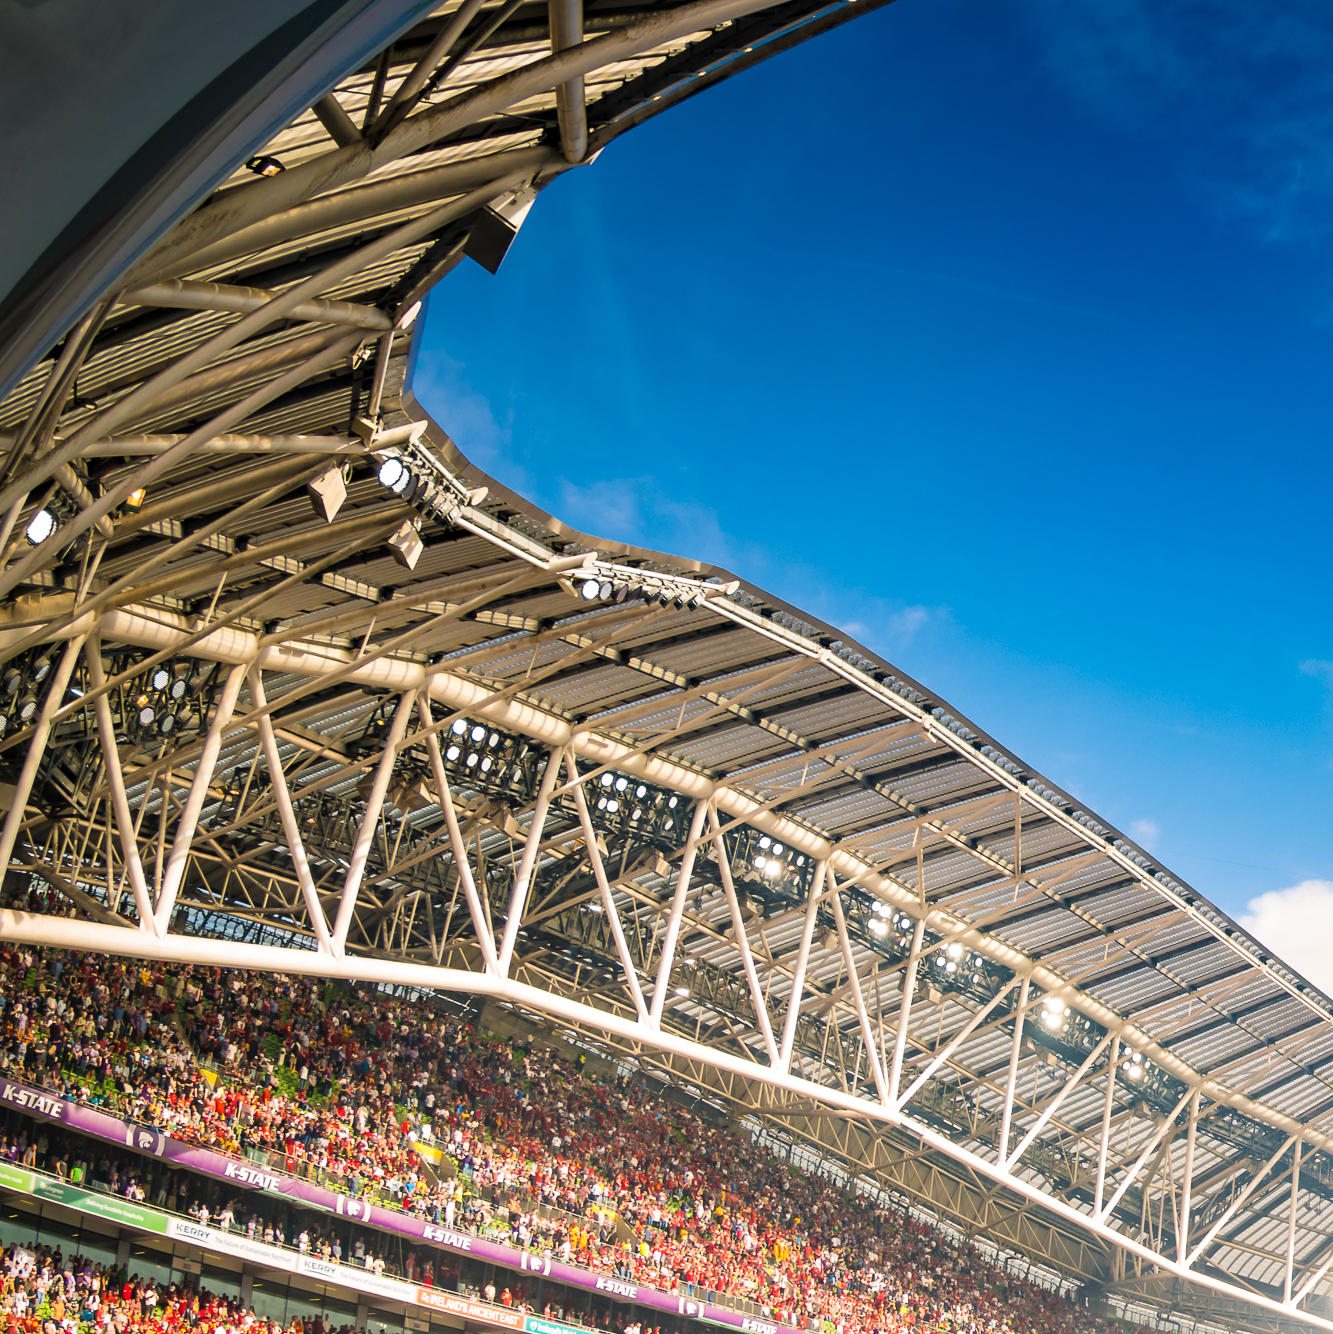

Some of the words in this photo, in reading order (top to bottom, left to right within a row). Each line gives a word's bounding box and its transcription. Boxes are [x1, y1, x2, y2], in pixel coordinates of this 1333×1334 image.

[1, 1084, 63, 1118] K-STATE
[225, 1162, 281, 1191] K-STATE
[175, 1223, 211, 1239] KERRY
[423, 1226, 472, 1250] K-STATE
[304, 1260, 337, 1274] KERRY
[596, 1277, 637, 1298] K-STATE
[468, 1304, 500, 1322] ANCIENT
[500, 1313, 520, 1326] EAST
